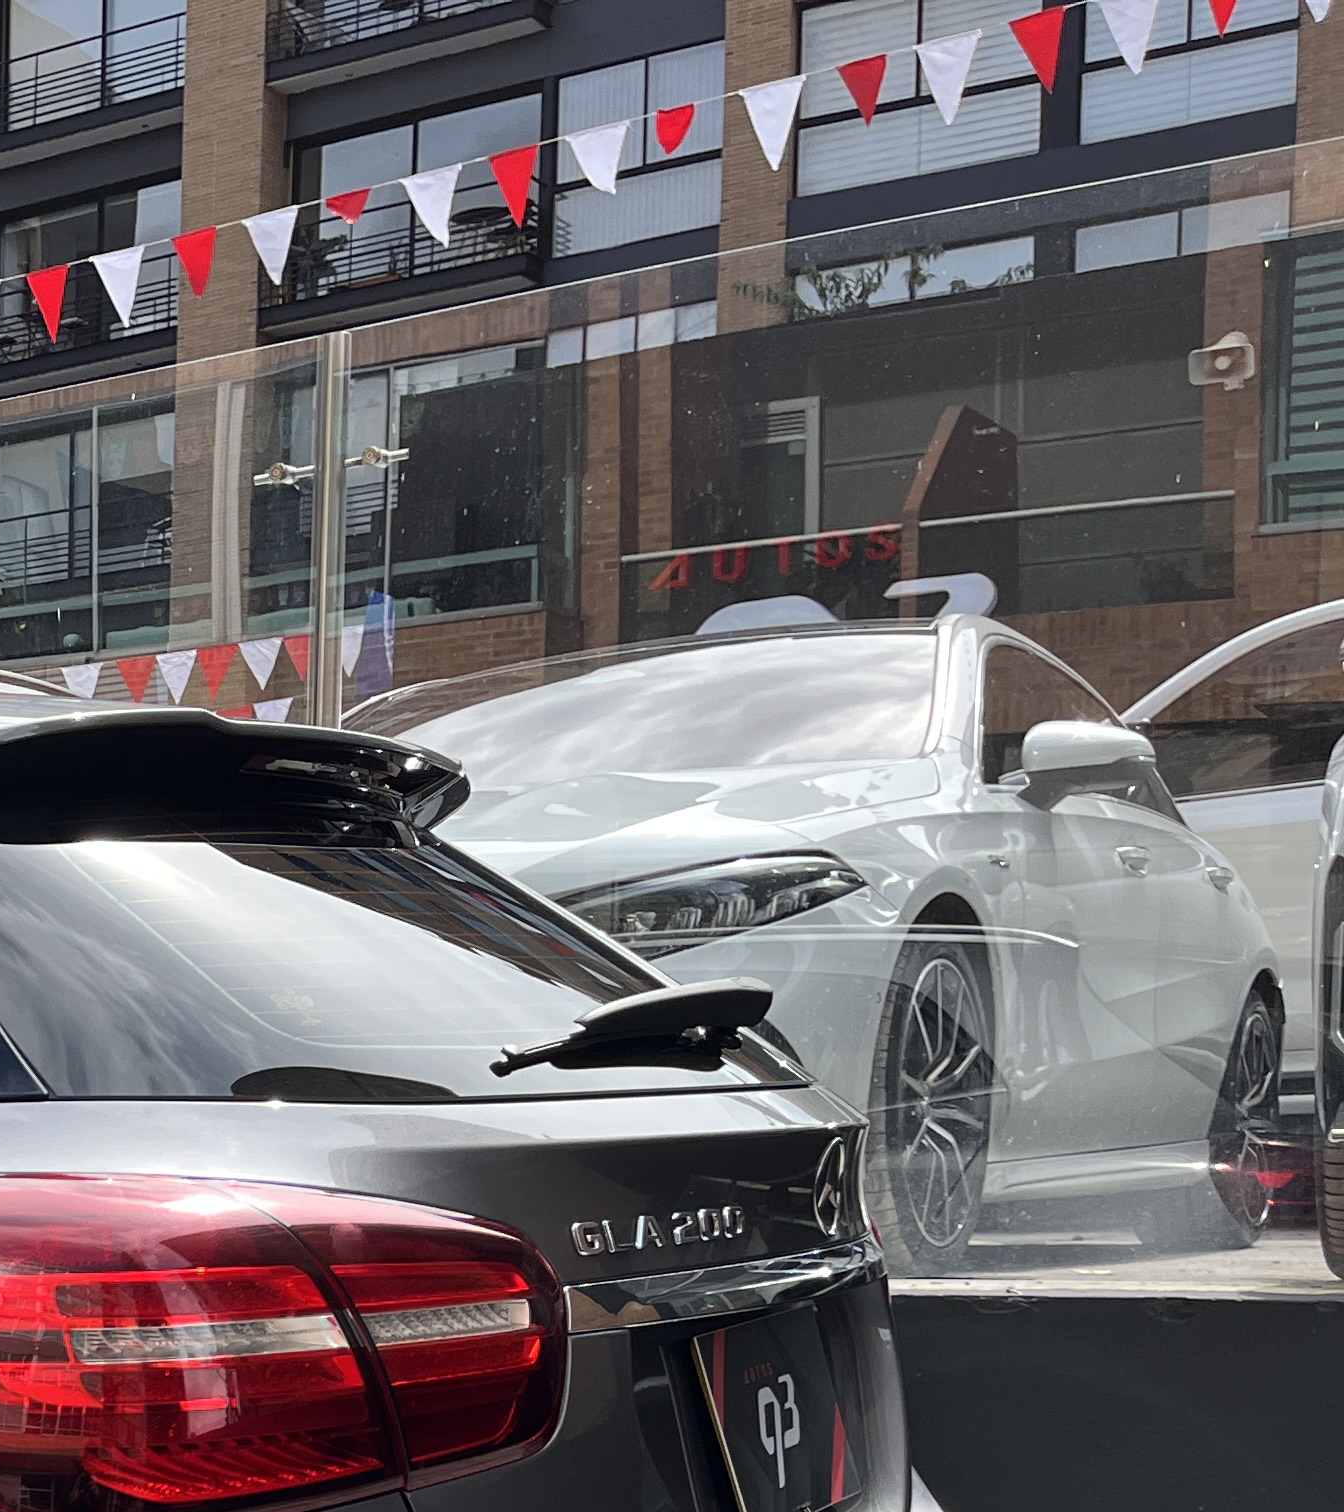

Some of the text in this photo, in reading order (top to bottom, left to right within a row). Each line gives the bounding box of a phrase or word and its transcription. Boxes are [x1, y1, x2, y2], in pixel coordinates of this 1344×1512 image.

[648, 523, 901, 590] AUTOS
[571, 1206, 745, 1256] GLA 200
[757, 1373, 800, 1489] 93
